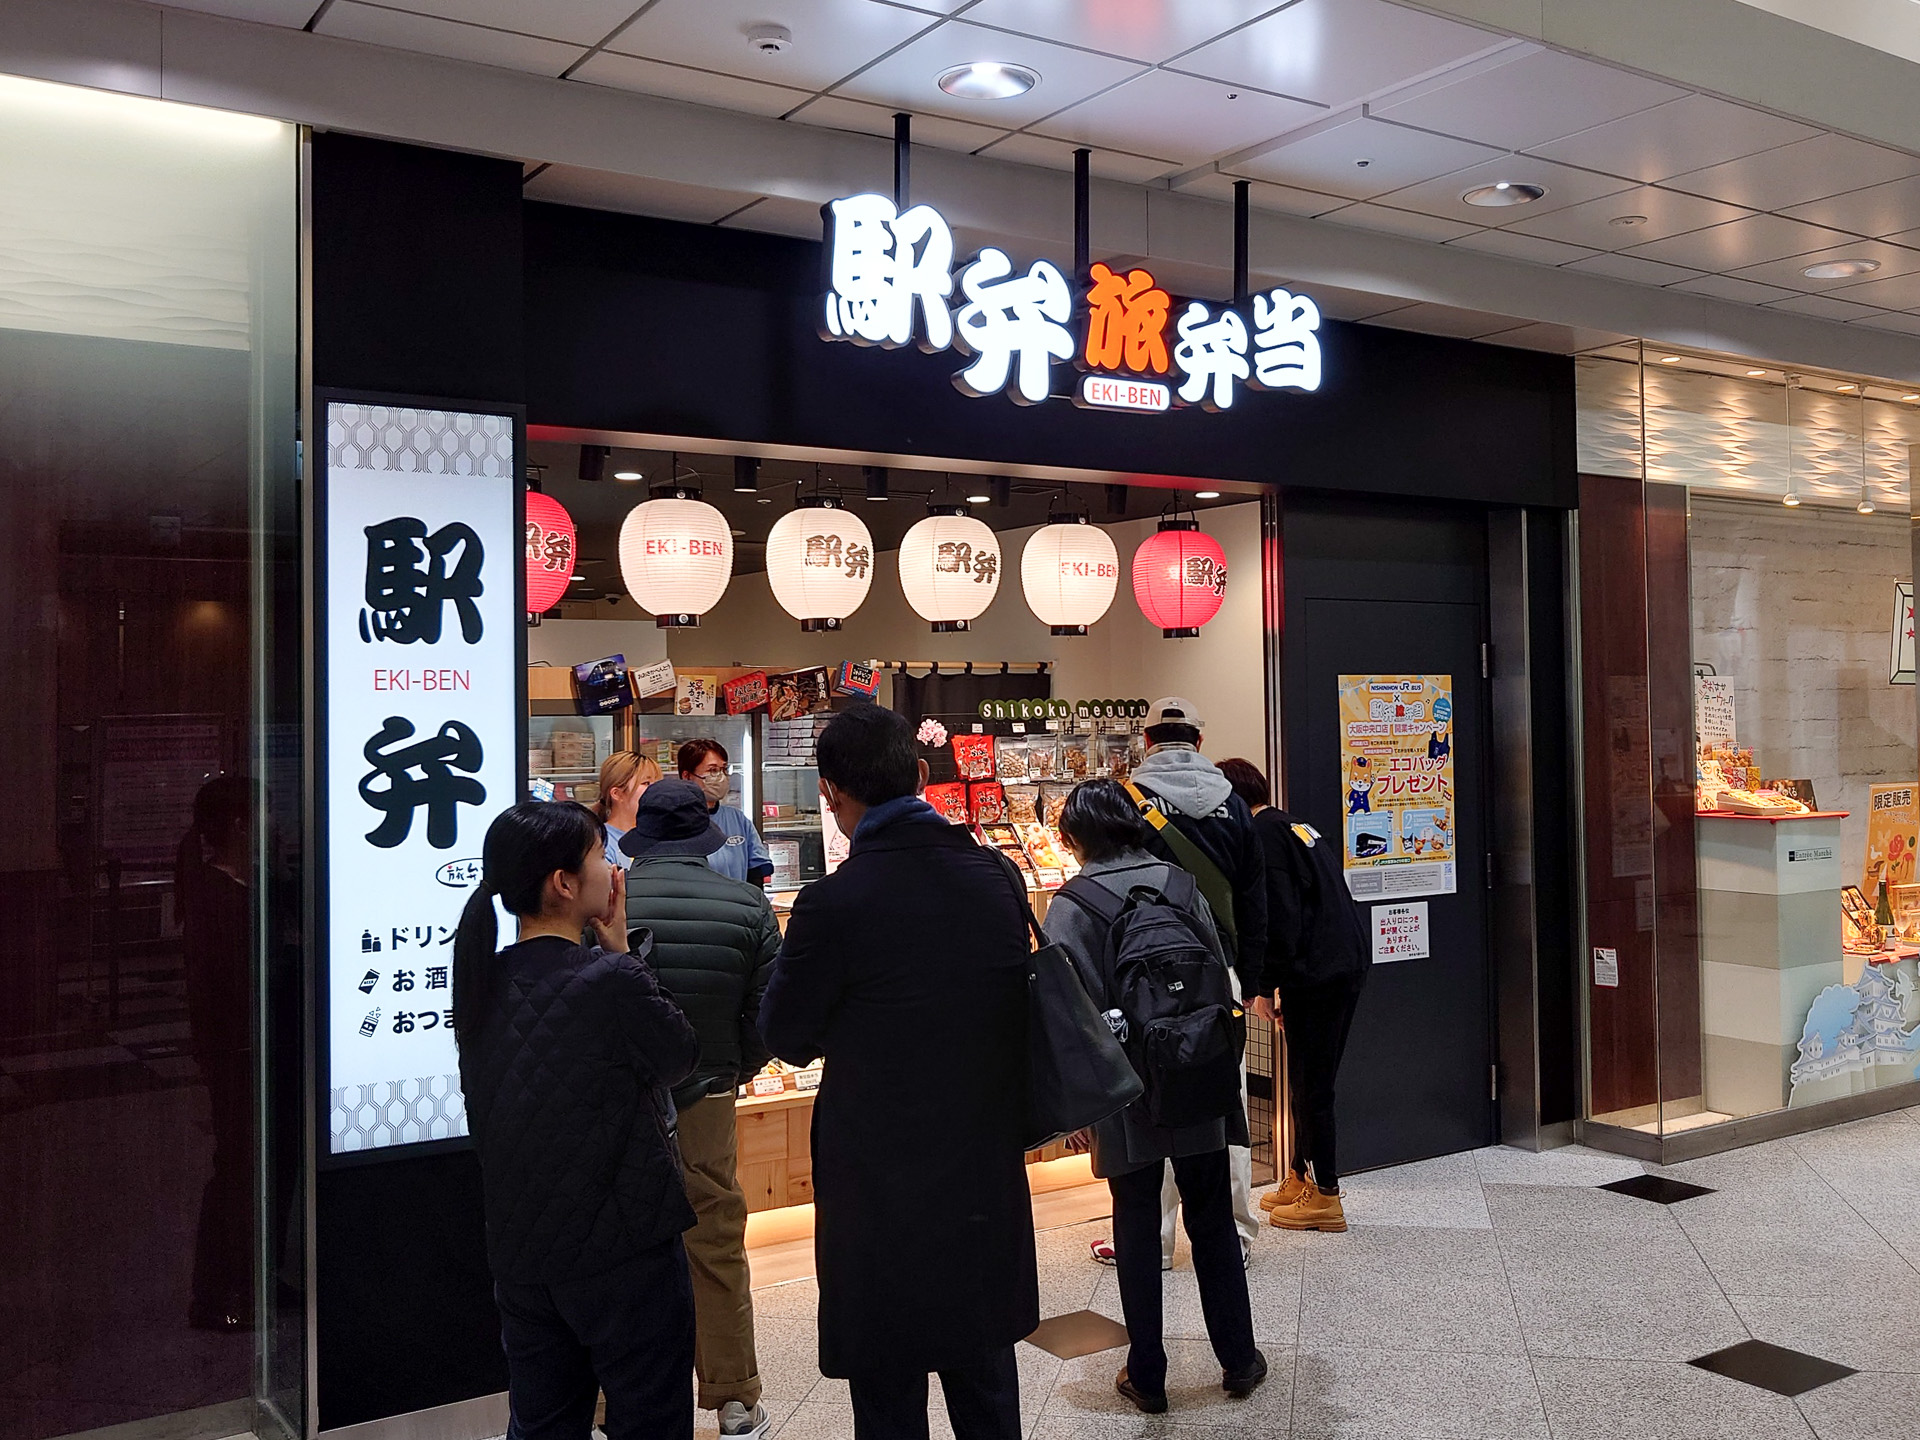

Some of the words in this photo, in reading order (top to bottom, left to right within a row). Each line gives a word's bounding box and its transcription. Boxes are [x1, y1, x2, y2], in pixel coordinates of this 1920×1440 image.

[1090, 380, 1163, 407] EKI-BEN
[646, 539, 723, 556] EKI-BEN
[805, 534, 870, 580] 駅弁
[936, 541, 997, 585] 駅弁
[373, 669, 471, 692] EKI-BEN
[1399, 682, 1410, 691] JR
[982, 703, 1068, 719] Shikoku
[1078, 704, 1147, 720] meguru
[1390, 754, 1447, 772] エコバッグ
[1377, 774, 1448, 795] プレゼント
[1874, 790, 1911, 810] 限定販売
[1380, 916, 1419, 926] 出入り口につき
[1379, 944, 1420, 954] ご注意ください。
